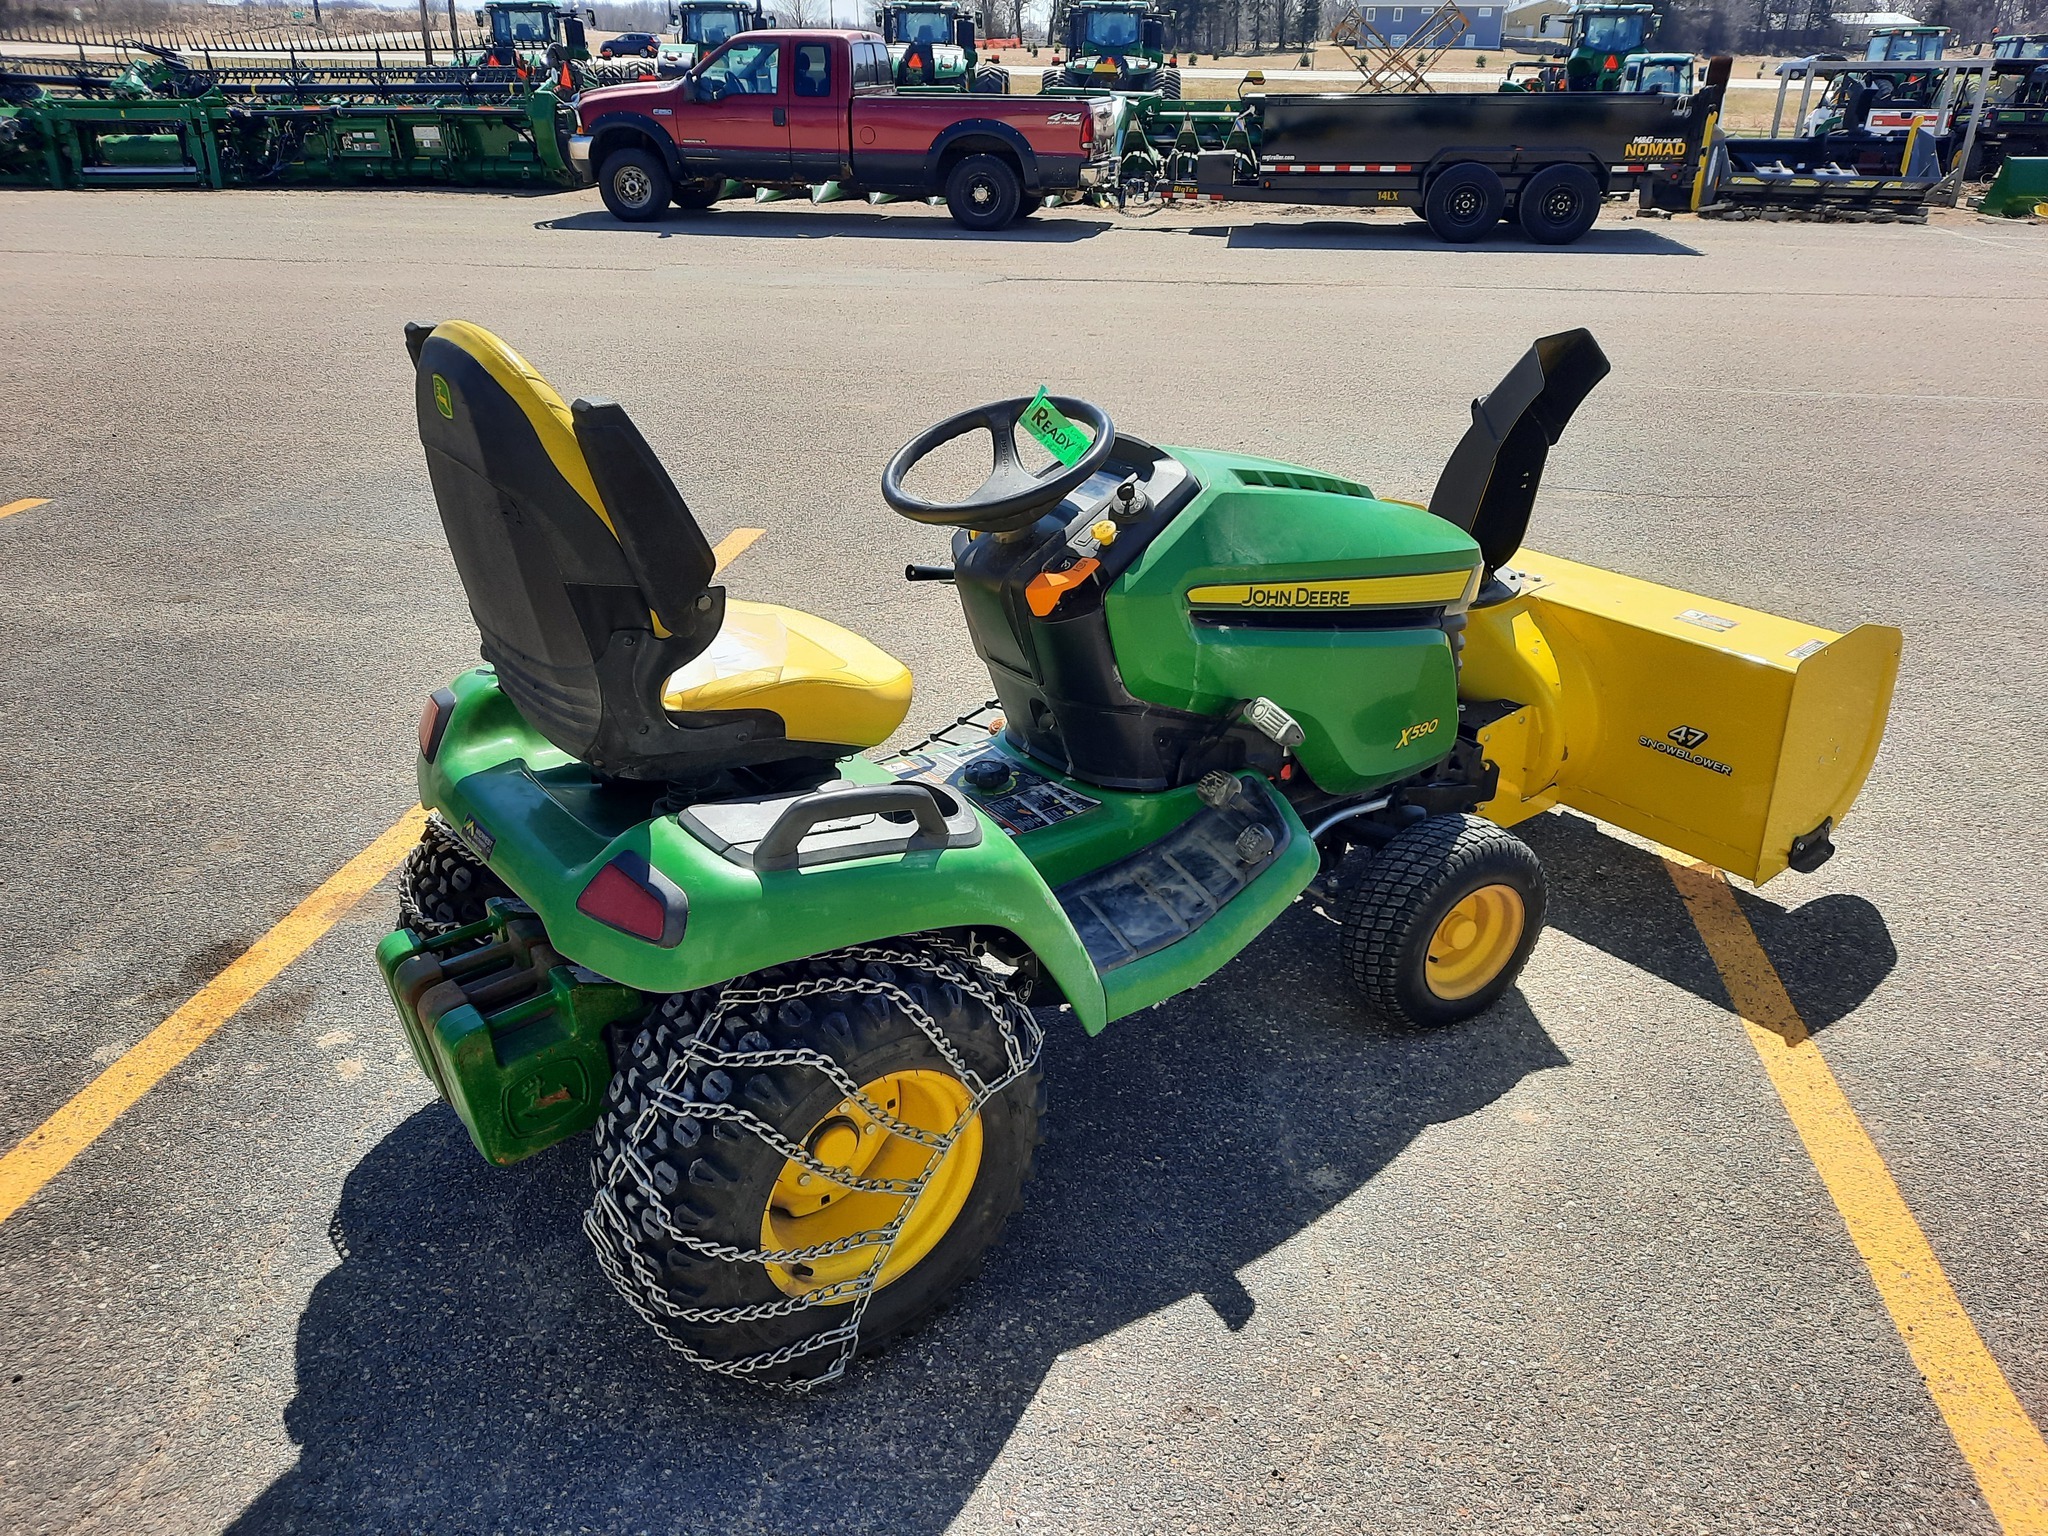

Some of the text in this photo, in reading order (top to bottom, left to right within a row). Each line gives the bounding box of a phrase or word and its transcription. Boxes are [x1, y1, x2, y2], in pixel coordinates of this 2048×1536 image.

[1624, 142, 1687, 157] NOMAD
[1632, 135, 1654, 144] M&G
[1173, 185, 1199, 194] BigTex
[1377, 191, 1399, 201] 14LX
[1031, 406, 1075, 450] READY
[1241, 586, 1351, 607] JOHN DEERE
[1394, 718, 1439, 750] X590
[1668, 725, 1708, 749] 47
[1638, 735, 1733, 776] SNOWBLOWER
